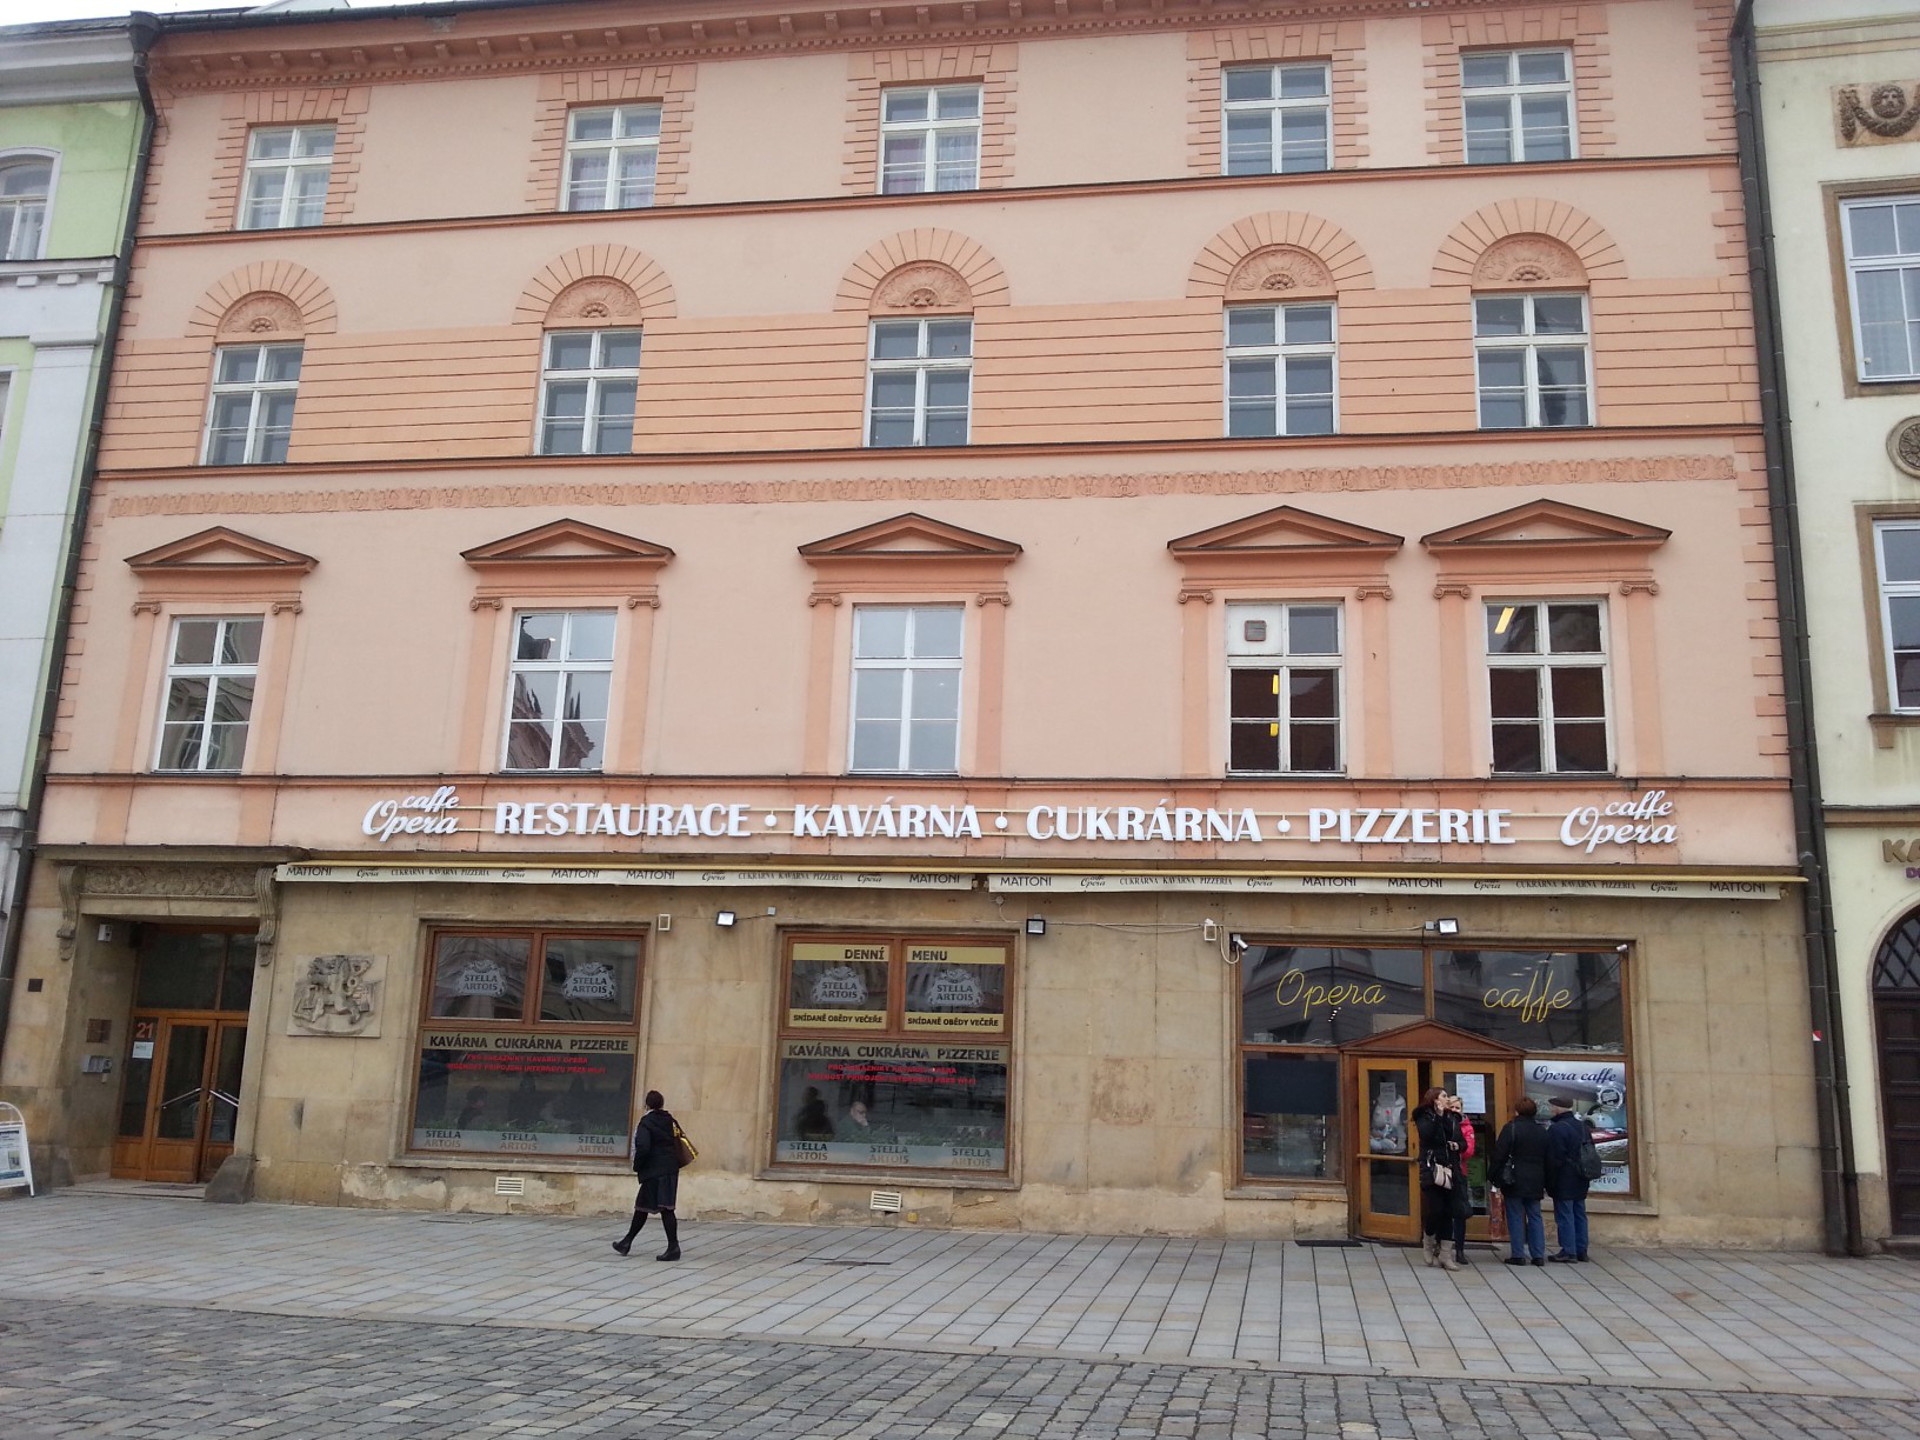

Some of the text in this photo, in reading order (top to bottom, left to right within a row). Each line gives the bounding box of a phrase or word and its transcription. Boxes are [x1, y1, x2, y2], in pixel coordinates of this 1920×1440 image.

[402, 785, 460, 810] caffe
[1604, 790, 1673, 820] caffe
[362, 799, 460, 842] Opera
[494, 796, 1516, 845] RESTAURACE KAVÁRNA CUKRÁRNA PIZZERIE
[1560, 805, 1678, 854] Opera
[286, 867, 332, 876] MATTONI
[551, 870, 599, 879] MATTONI
[626, 870, 675, 880] MATTONI
[909, 874, 960, 884] MATTONI
[1000, 877, 1051, 887] MATTONI
[1302, 877, 1356, 887] MATTONI
[1387, 878, 1442, 888] MATTONI
[1709, 881, 1765, 892] MATTONI
[844, 947, 948, 961] DENNÍ MENU
[464, 974, 497, 983] STELLA
[572, 977, 607, 986] STELLA
[463, 982, 498, 991] ARTOIS
[572, 985, 607, 994] ARTOIS
[821, 981, 857, 990] STELLA
[936, 984, 973, 993] STELLA
[820, 990, 857, 998] ARTOIS
[936, 993, 974, 1001] ARTOIS
[1277, 968, 1387, 1019] Opera
[1484, 970, 1572, 1023] caffe
[136, 1022, 154, 1039] 21
[430, 1034, 629, 1051] KAVÁRNA CUKRÁRNA PIZZERIE
[788, 1043, 999, 1060] KAVÁRNA CUKRÁRNA PIZZERIE
[1533, 1065, 1617, 1084] Opera caffe
[426, 1130, 461, 1139] STELLA
[501, 1132, 537, 1141] STELLA
[424, 1139, 461, 1148] ARTOIS
[578, 1135, 615, 1145] STELLA
[500, 1141, 537, 1150] ARTOIS
[577, 1144, 614, 1154] ARTOIS
[789, 1141, 828, 1151] STELLA
[870, 1145, 908, 1154] STELLA
[789, 1151, 828, 1161] ARTOIS
[952, 1148, 991, 1157] STELLA
